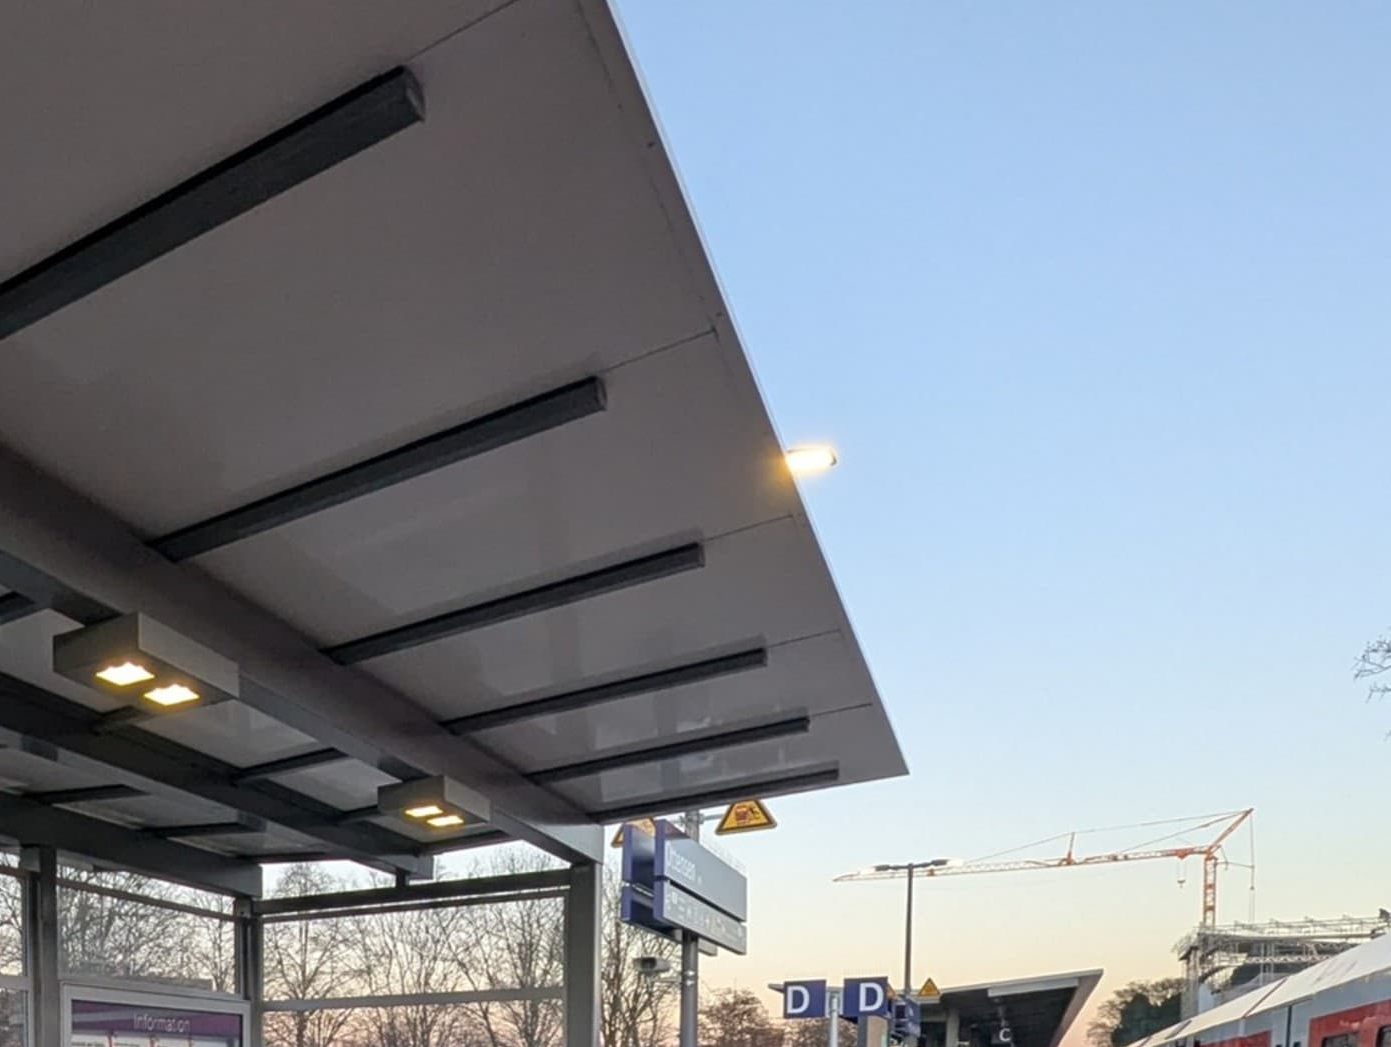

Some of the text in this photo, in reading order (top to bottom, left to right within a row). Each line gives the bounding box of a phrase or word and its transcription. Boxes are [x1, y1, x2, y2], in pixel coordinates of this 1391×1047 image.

[787, 986, 810, 1014] D
[859, 982, 884, 1012] D
[133, 1014, 191, 1033] Information
[999, 1027, 1011, 1042] C
